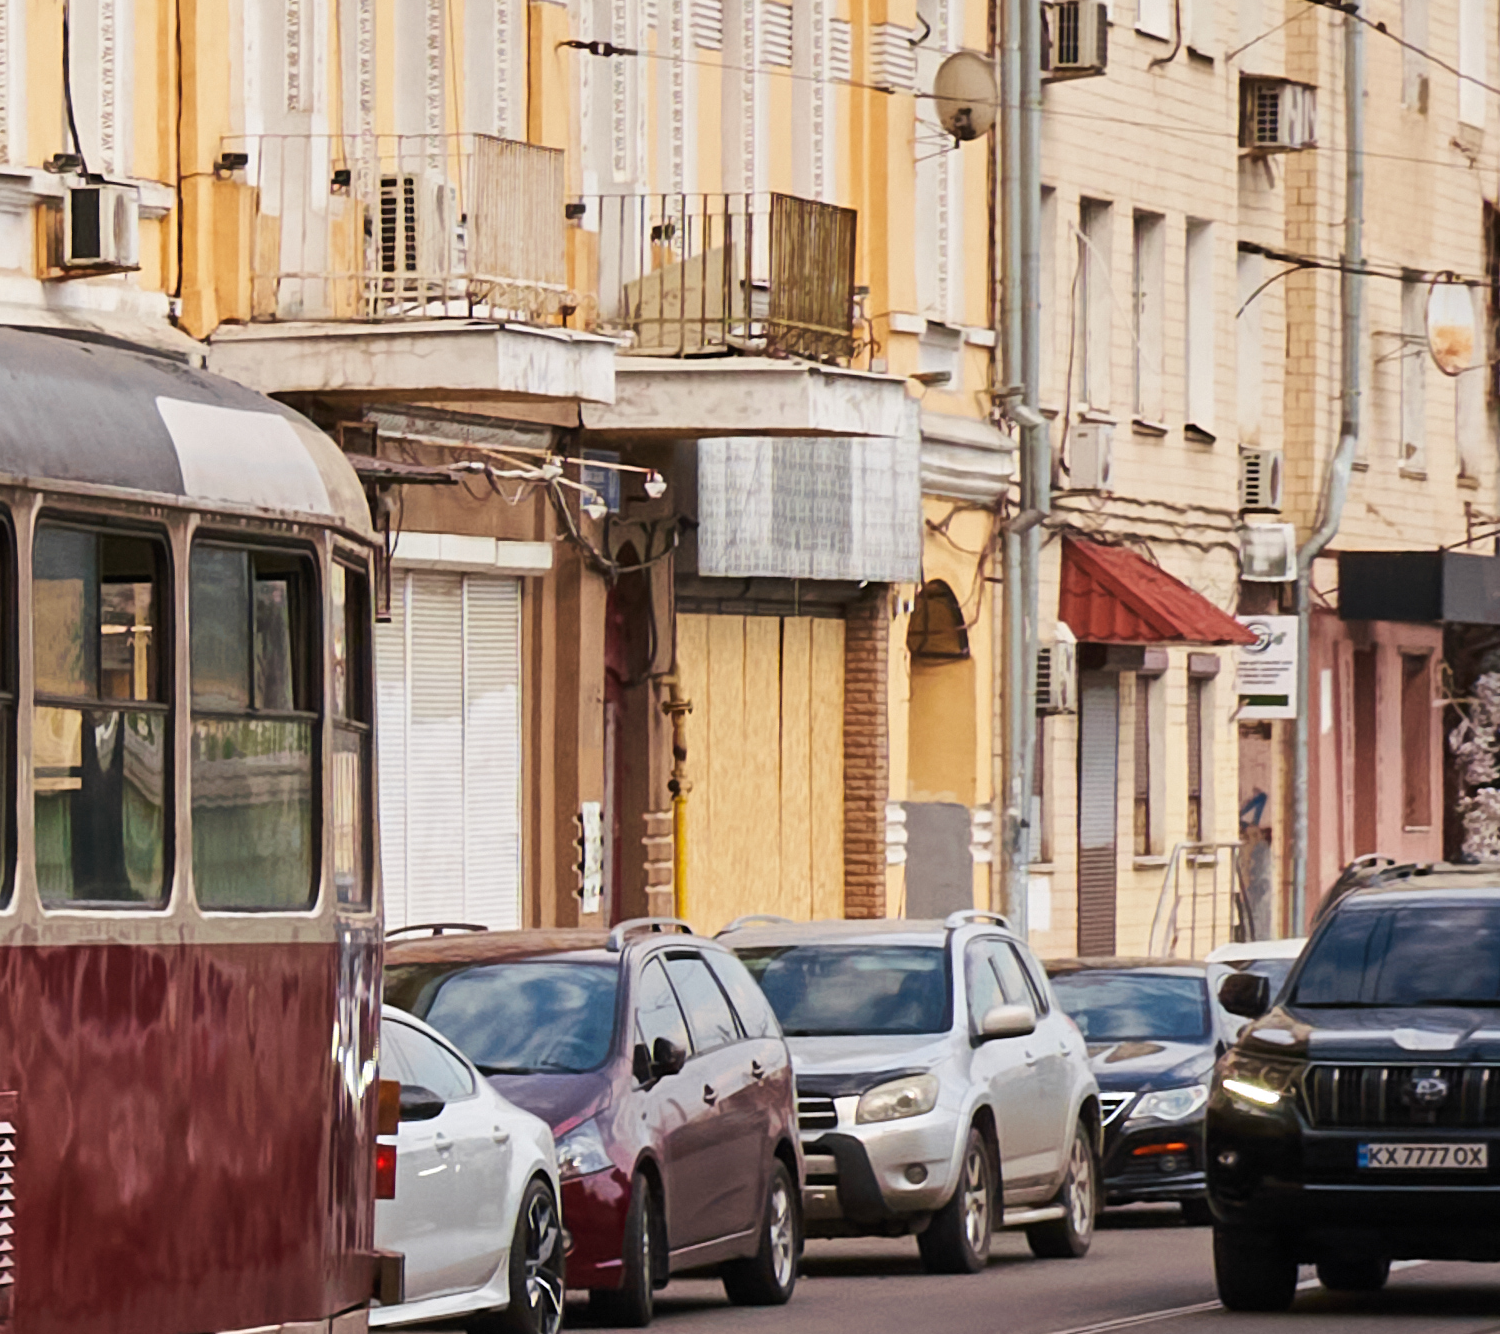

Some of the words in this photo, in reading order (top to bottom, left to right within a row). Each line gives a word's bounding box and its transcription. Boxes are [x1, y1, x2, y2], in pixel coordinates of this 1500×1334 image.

[1369, 1147, 1398, 1165] KX
[1402, 1147, 1450, 1165] 7777
[1453, 1147, 1483, 1165] OX
